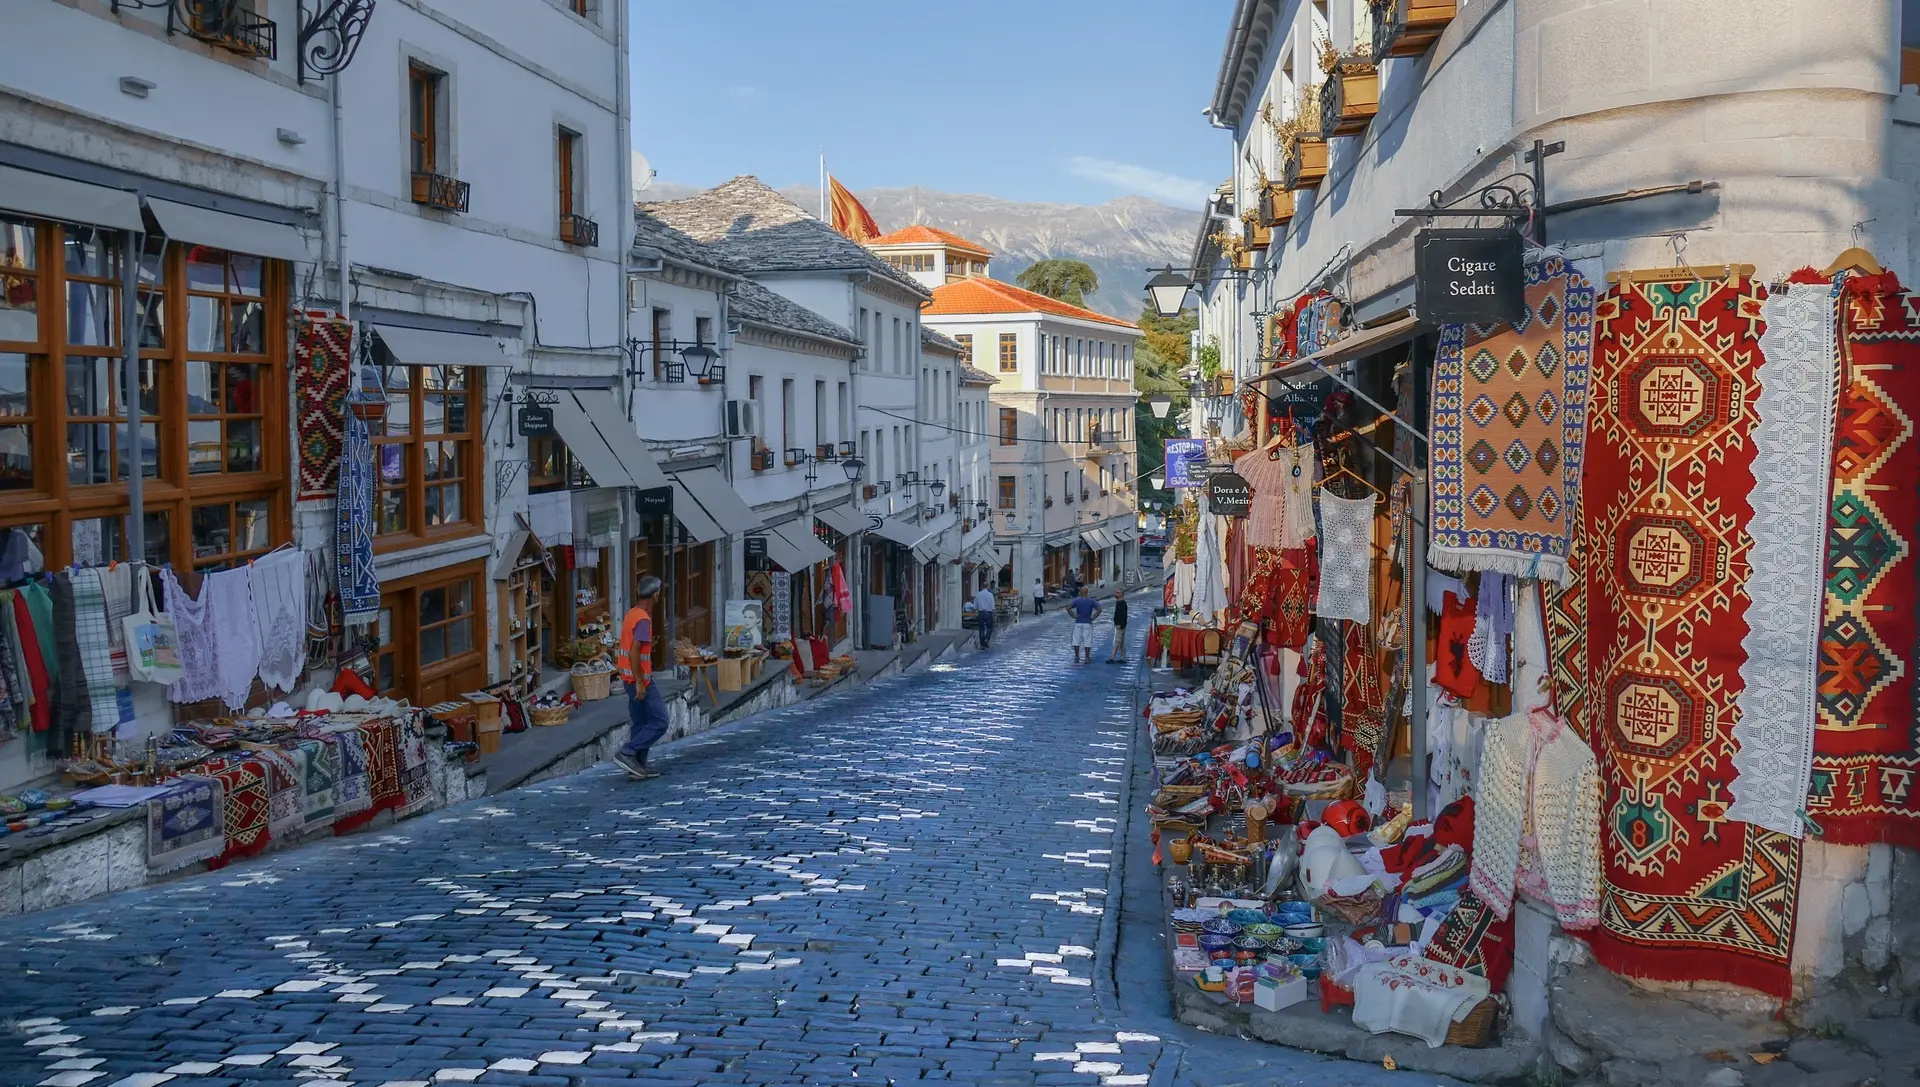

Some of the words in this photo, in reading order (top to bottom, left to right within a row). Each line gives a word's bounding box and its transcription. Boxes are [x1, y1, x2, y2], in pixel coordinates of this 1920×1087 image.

[1447, 257, 1497, 276] Cigare
[1449, 280, 1496, 296] Sedati
[1308, 382, 1319, 390] In
[1283, 393, 1318, 402] Albaia
[1214, 486, 1234, 494] Dora
